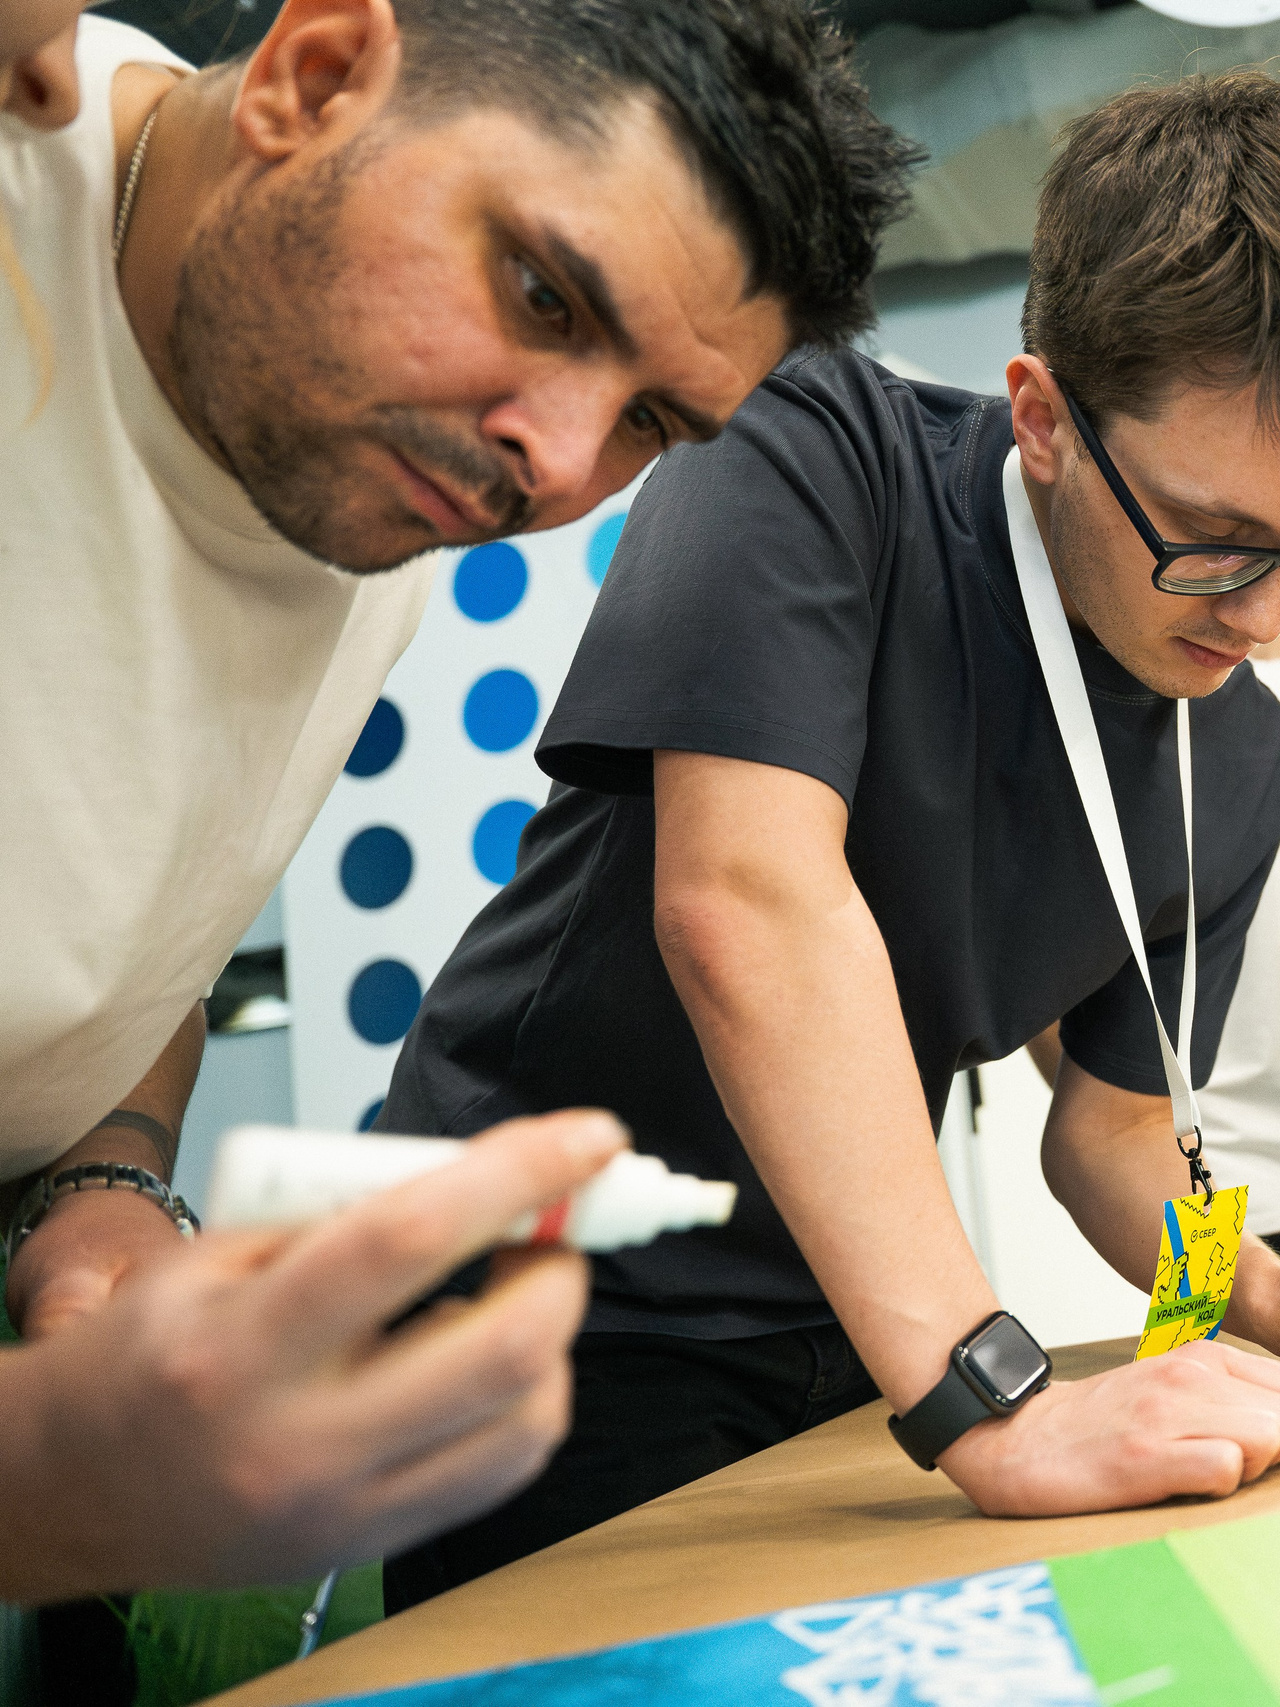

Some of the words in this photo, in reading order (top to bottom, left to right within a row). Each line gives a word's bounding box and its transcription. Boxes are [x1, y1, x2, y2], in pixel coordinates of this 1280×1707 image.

[1199, 1227, 1216, 1239] СБЕР
[1156, 1296, 1208, 1321] УРАЛЬСКИЙ
[1197, 1308, 1215, 1322] КОД
